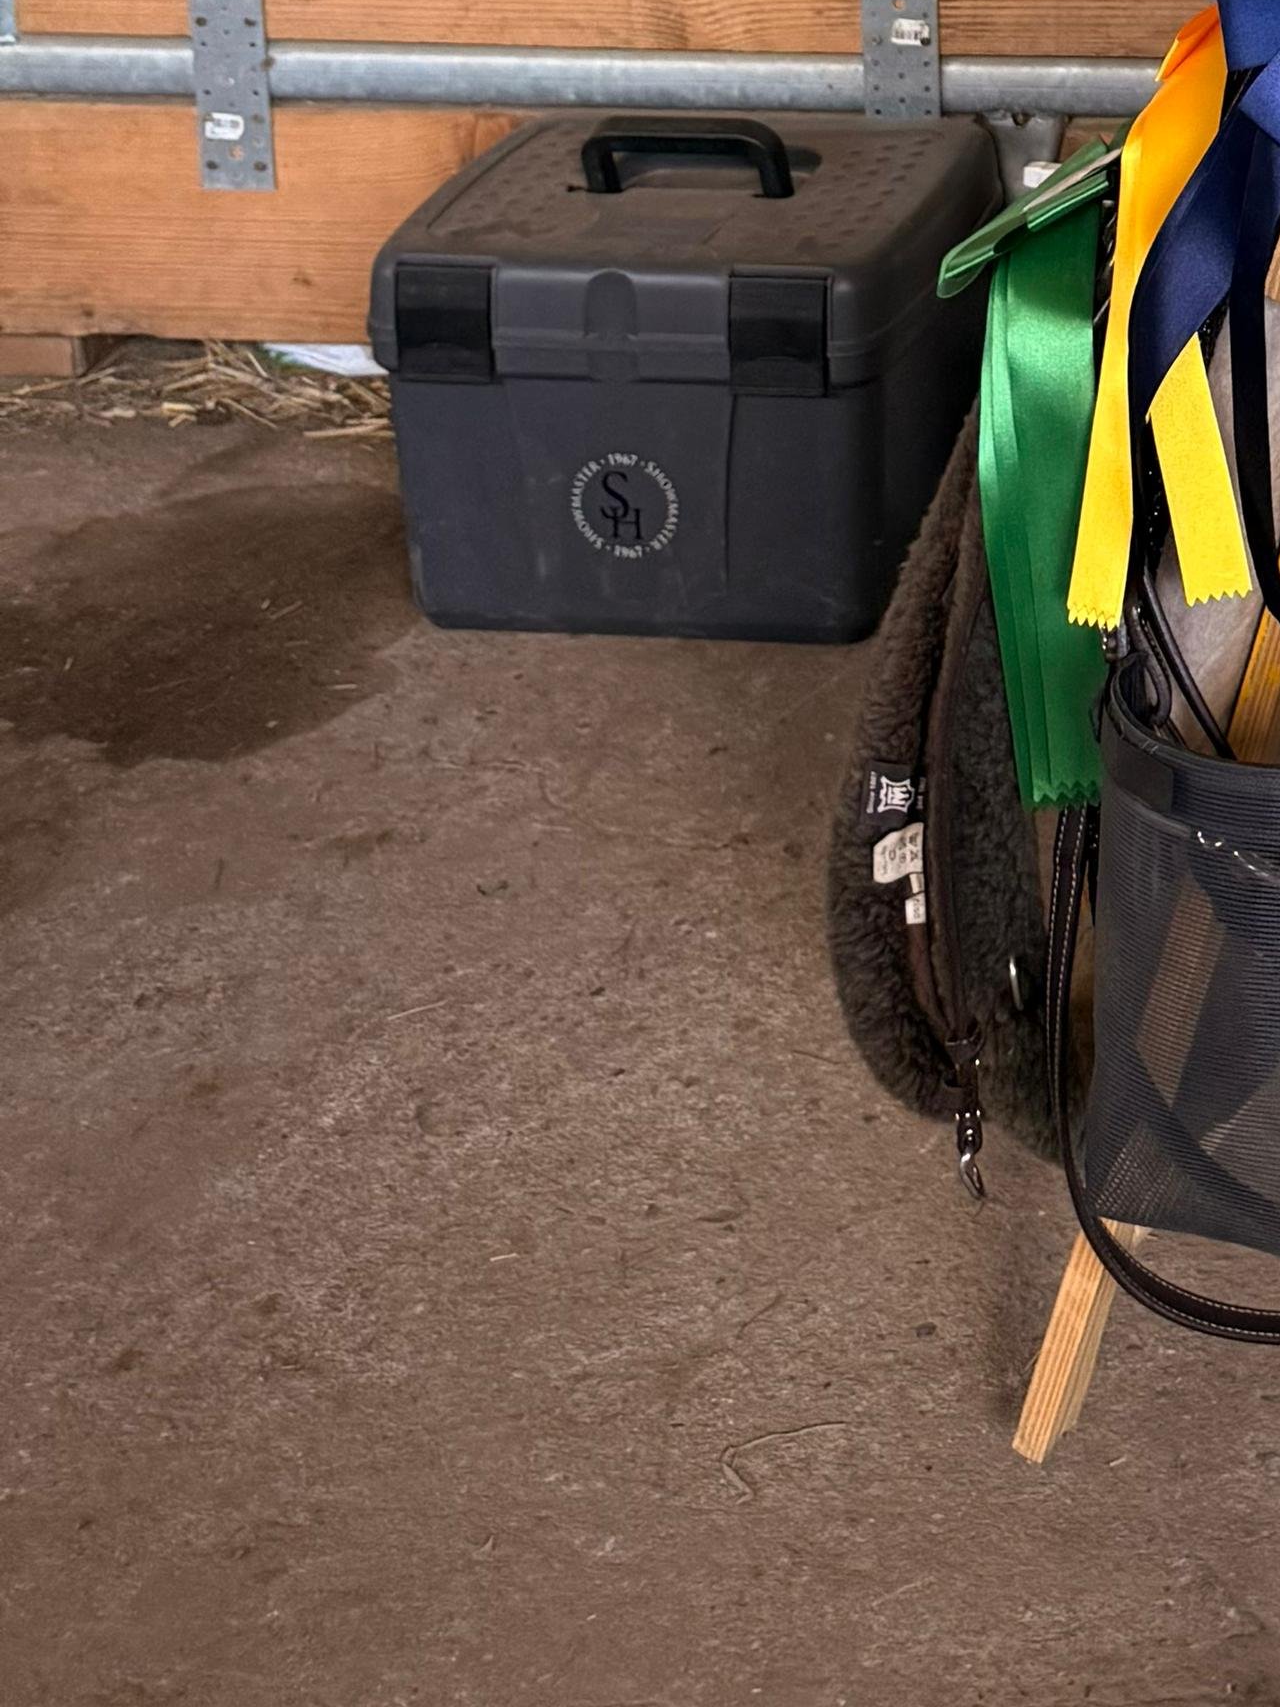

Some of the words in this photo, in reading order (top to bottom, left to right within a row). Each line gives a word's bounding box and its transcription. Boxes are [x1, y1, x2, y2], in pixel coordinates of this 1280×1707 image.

[607, 452, 638, 466] 1967
[570, 460, 603, 549] SHOWMASTER
[613, 544, 642, 558] 1967
